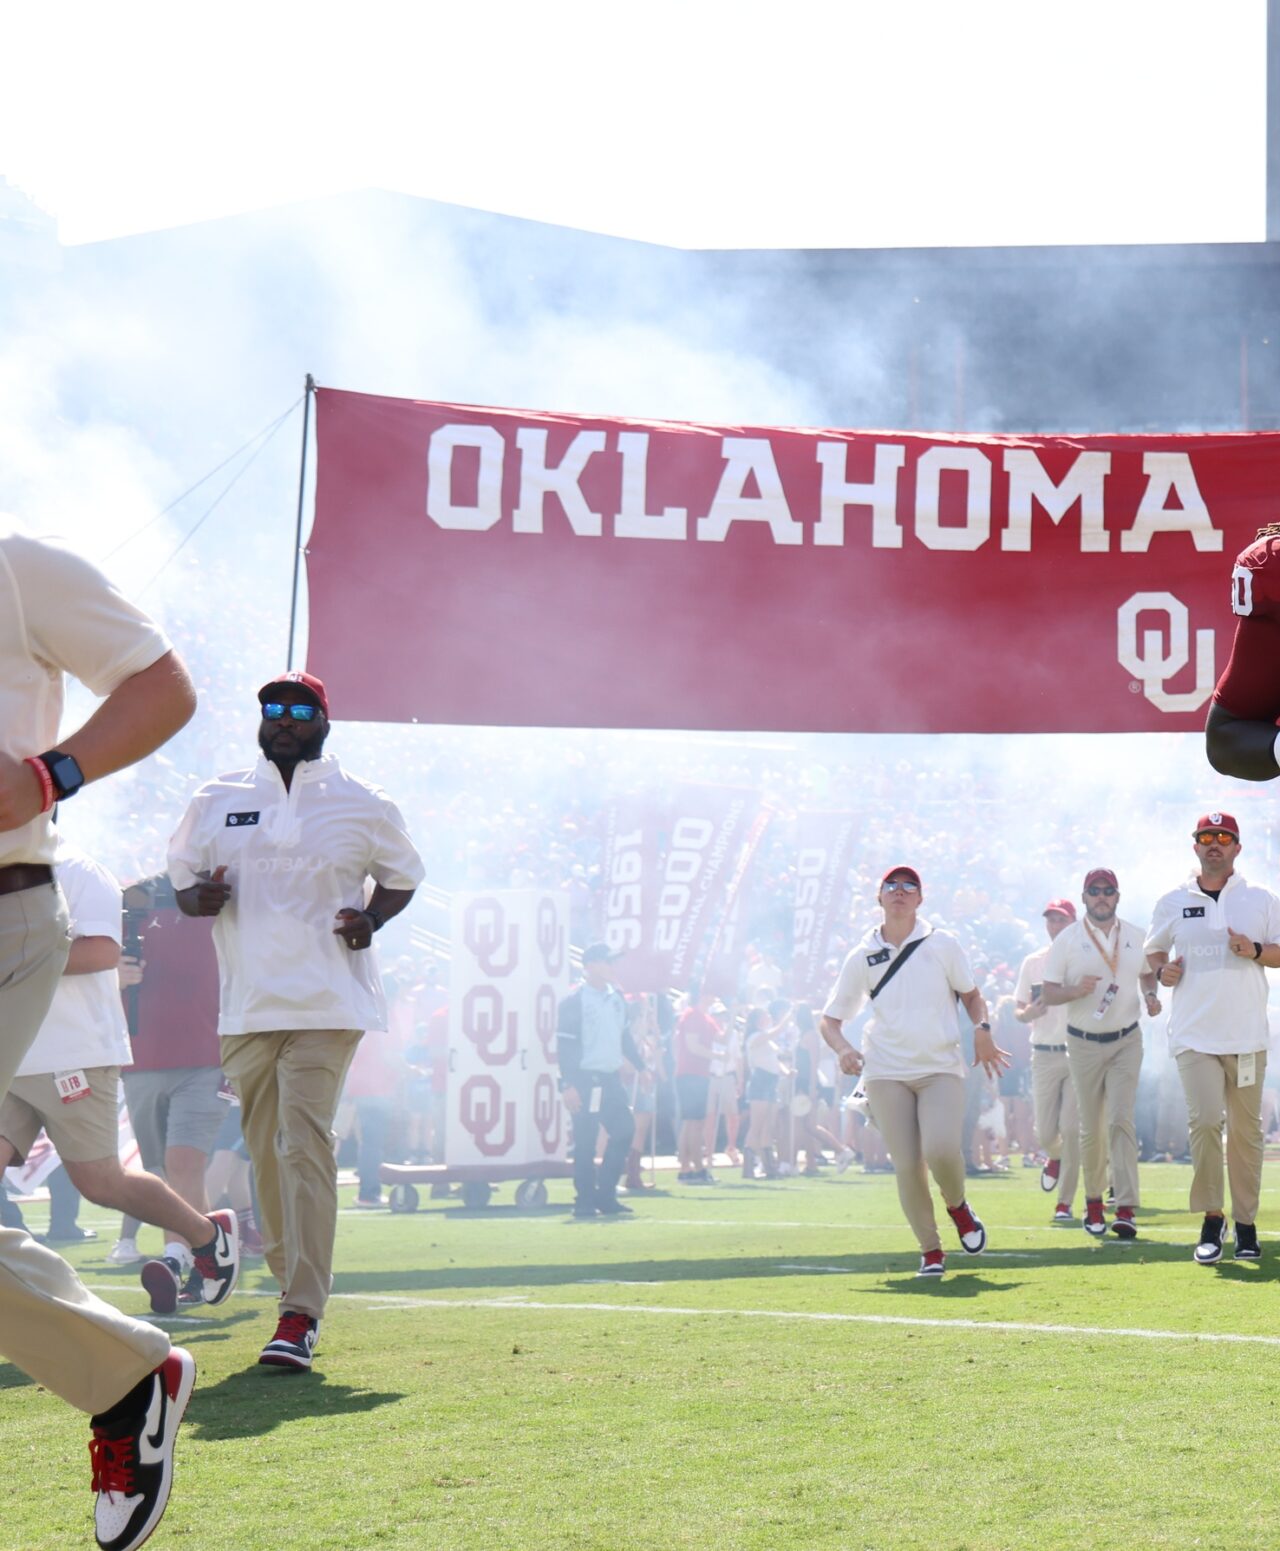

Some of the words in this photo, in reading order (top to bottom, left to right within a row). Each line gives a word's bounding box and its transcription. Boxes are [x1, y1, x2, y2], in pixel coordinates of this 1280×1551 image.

[427, 424, 1223, 552] OKLAHOMA
[1117, 592, 1215, 712] OU
[463, 897, 520, 978] OU
[606, 829, 643, 950] 1956
[655, 816, 714, 952] 2000
[671, 893, 705, 975] NATIONAL
[699, 798, 745, 892] CHAMPIONS
[793, 848, 827, 957] 1950
[462, 984, 518, 1065] OU
[459, 1074, 516, 1157] OU
